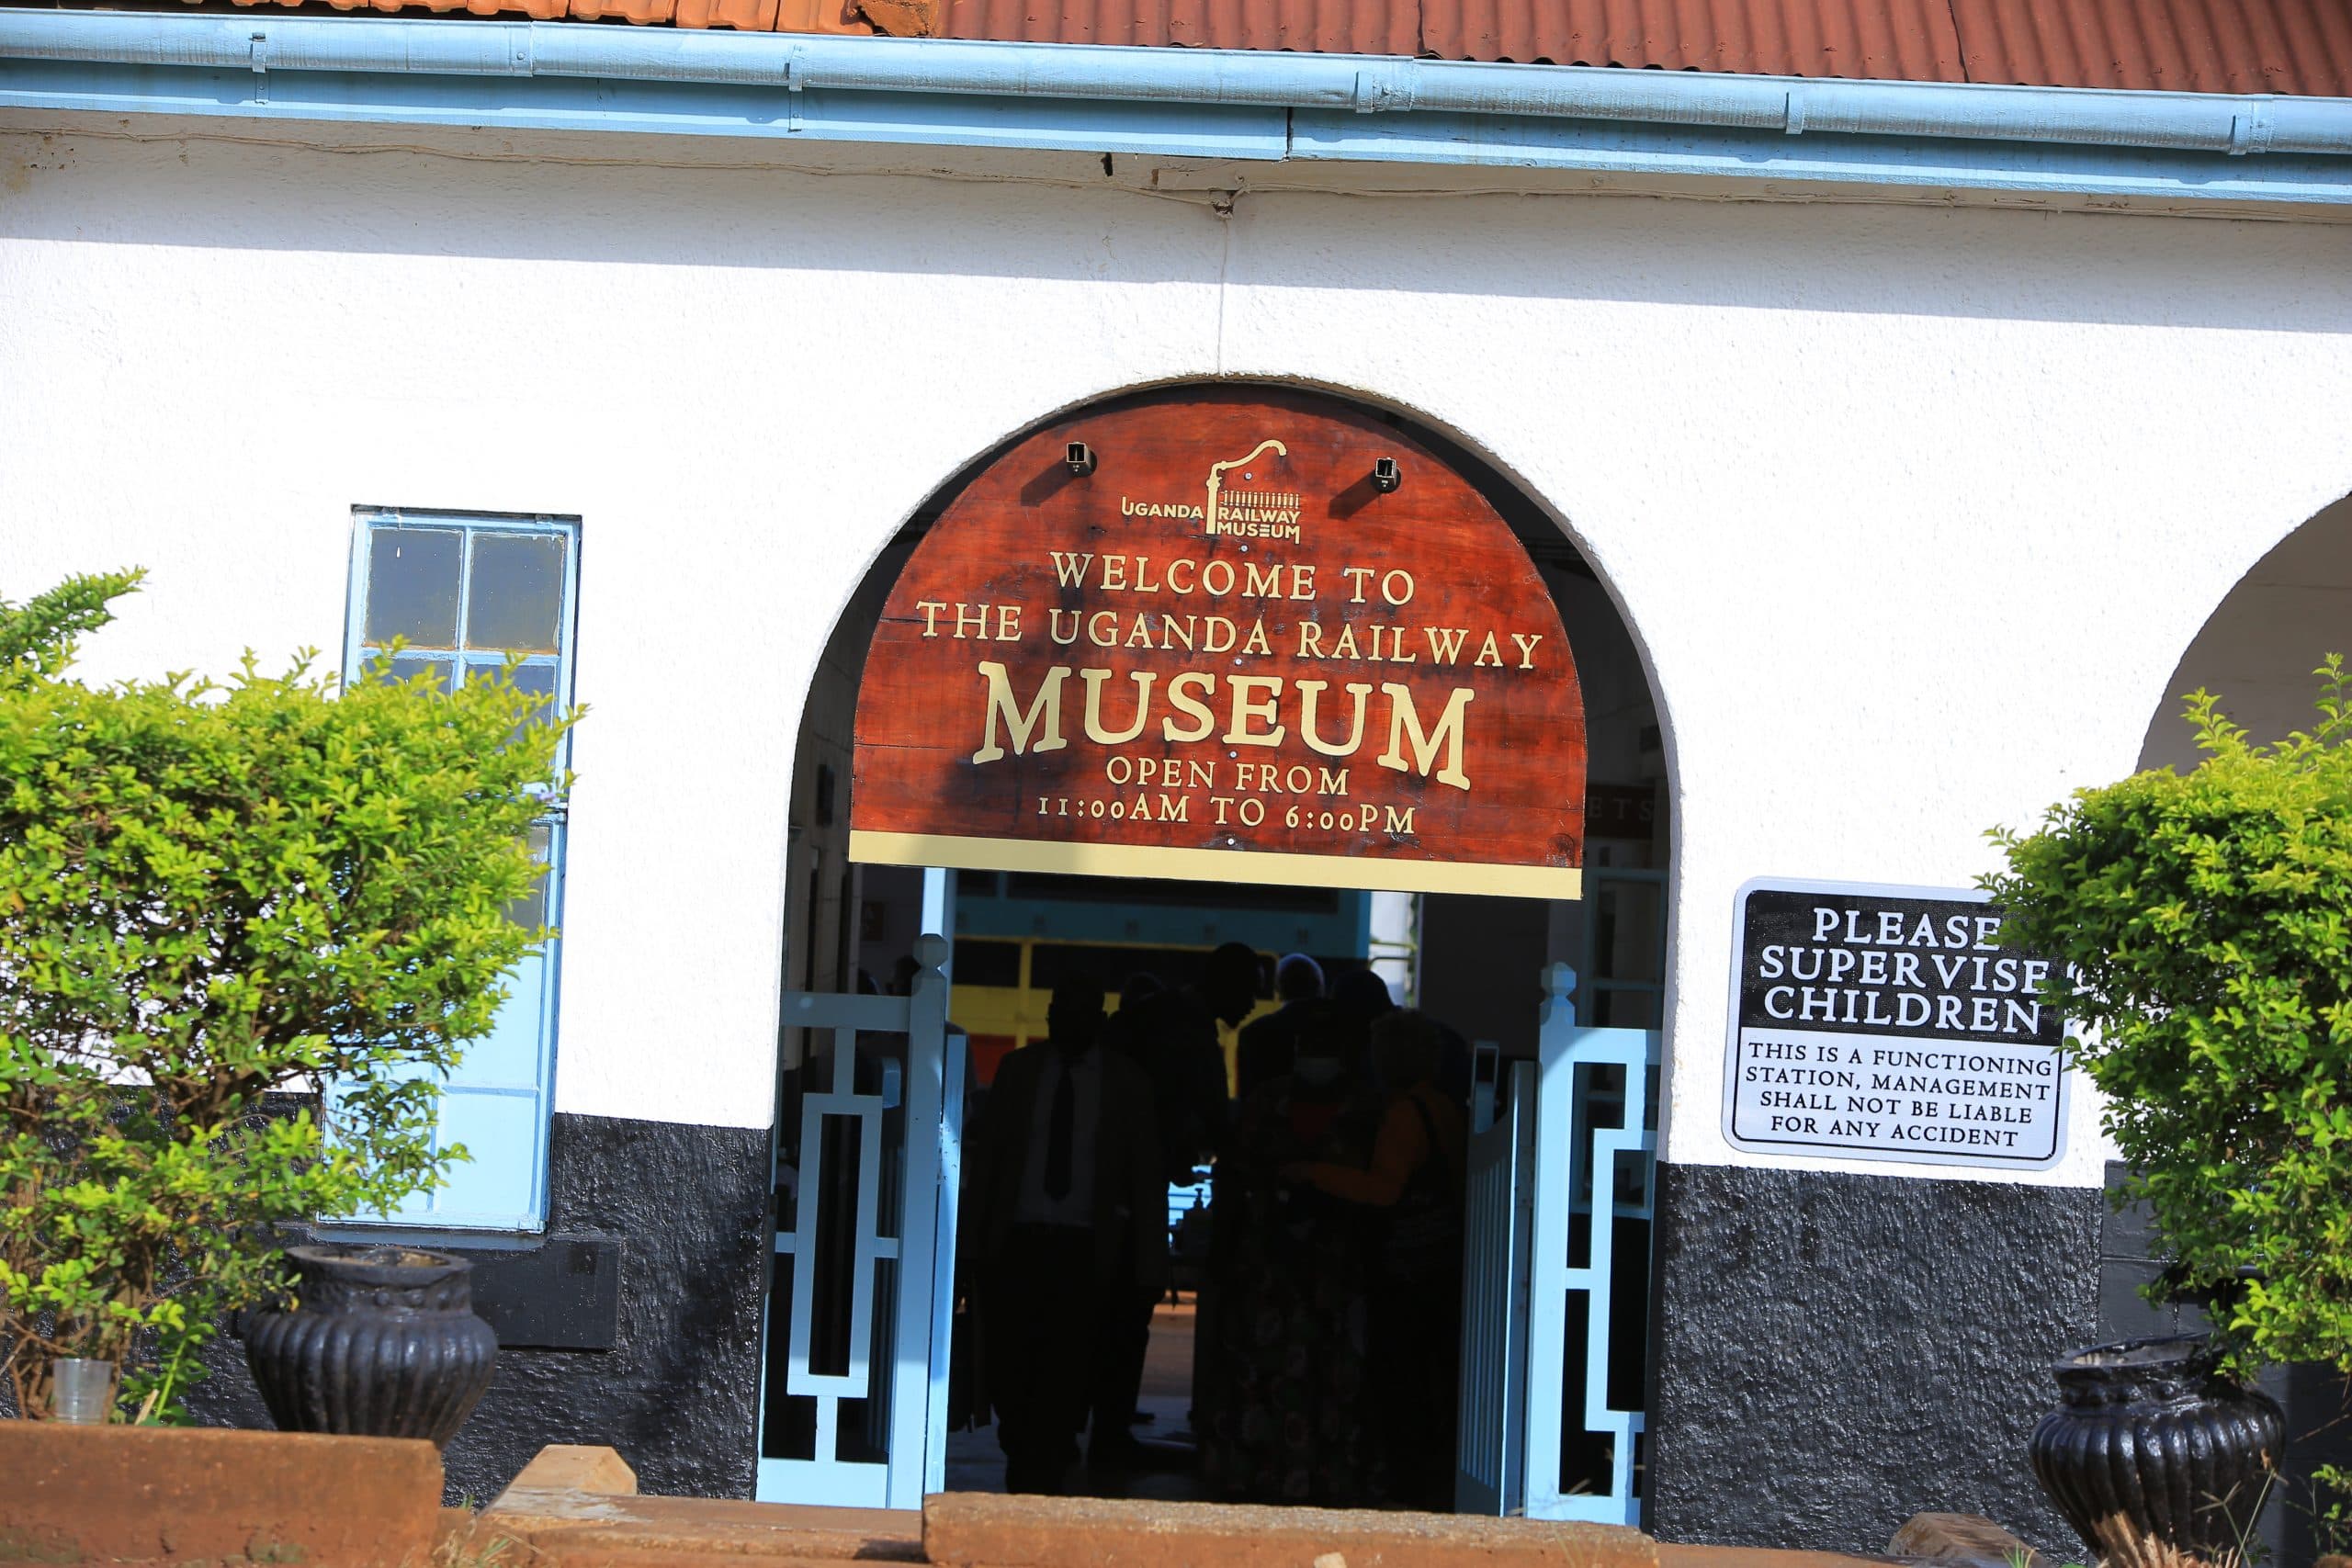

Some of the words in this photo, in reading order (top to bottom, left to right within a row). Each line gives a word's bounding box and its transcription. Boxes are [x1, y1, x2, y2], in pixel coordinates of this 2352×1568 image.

[1122, 497, 1204, 518] UGANDA
[1218, 507, 1301, 524] RAILWAY
[1217, 522, 1300, 544] MUSEUM
[1050, 552, 1316, 600] WELCOME
[1343, 568, 1414, 604] TO
[916, 601, 1022, 640] THE
[1049, 609, 1272, 654] UGANDA
[1297, 621, 1543, 669] RAILWAY
[973, 661, 1475, 791] MUSEUM
[1107, 757, 1216, 788] OPEN
[1236, 763, 1349, 795] FROM
[1039, 793, 1190, 822] 11:00AM
[1210, 796, 1264, 826] TO
[1286, 804, 1415, 834] 6:00PM
[1813, 908, 2000, 951] PLEASE
[1760, 945, 2049, 994] SUPERVISE
[1765, 987, 2041, 1034] CHILDREN
[1748, 1043, 1805, 1060] THIS
[1817, 1046, 1838, 1062] IS
[1849, 1049, 1861, 1064] A
[1873, 1050, 2051, 1076] FUNCTIONING
[1747, 1066, 1860, 1089] STATION,
[1871, 1074, 2050, 1100] MANAGEMENT
[1760, 1091, 1837, 1111] SHALL
[1848, 1097, 1901, 1114] NOT
[1911, 1101, 1938, 1117] BE
[1950, 1104, 2031, 1123] LIABLE
[1771, 1116, 1818, 1134] FOR
[1829, 1120, 1880, 1137] ANY
[1891, 1124, 2018, 1146] ACCIDENT
